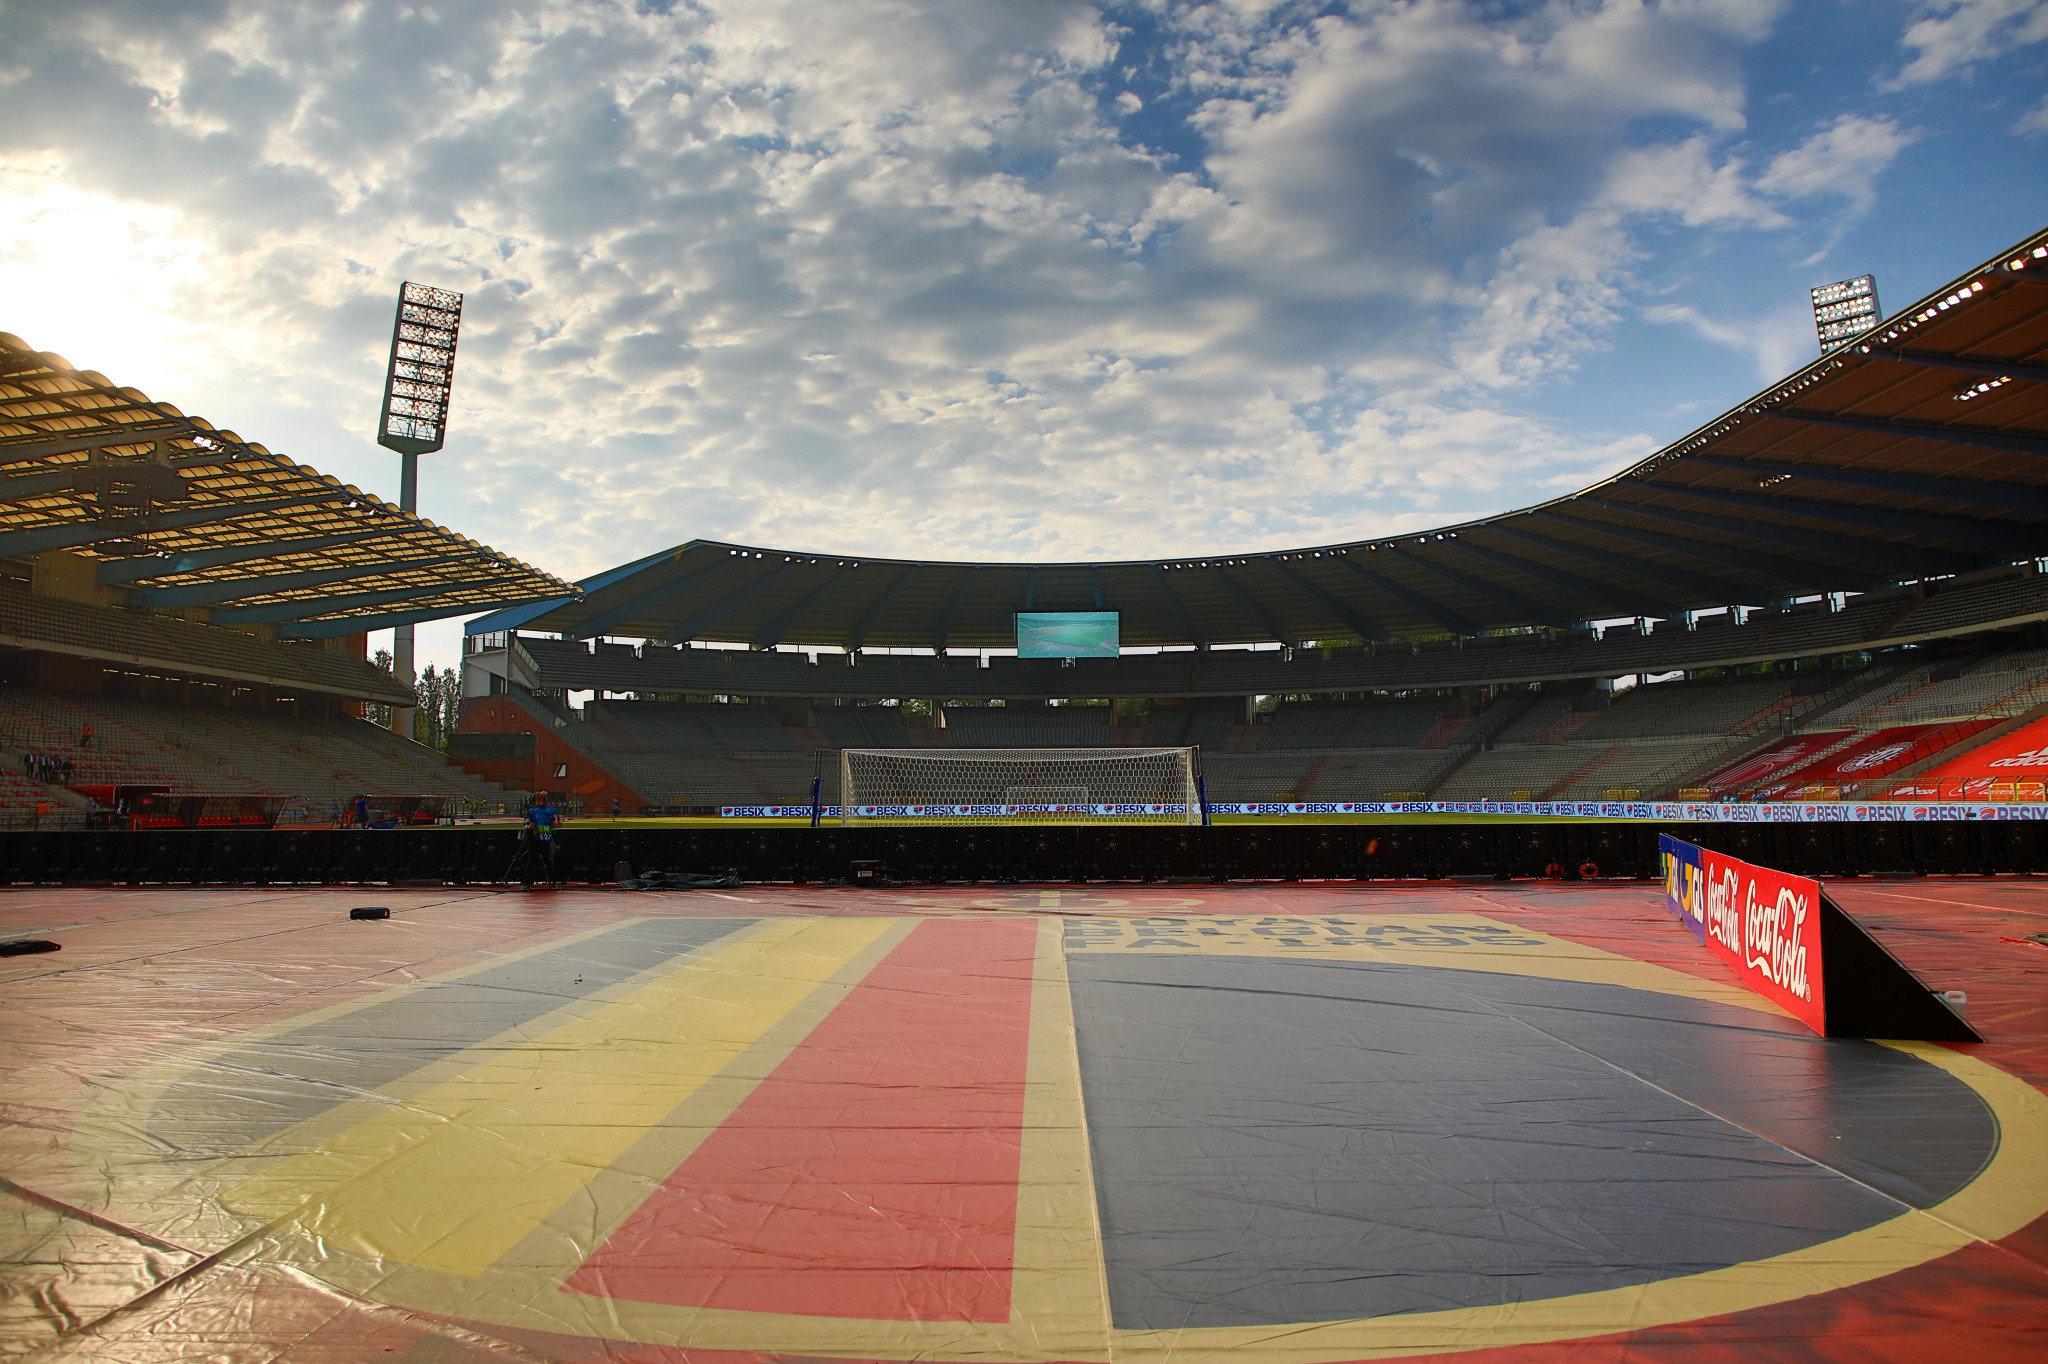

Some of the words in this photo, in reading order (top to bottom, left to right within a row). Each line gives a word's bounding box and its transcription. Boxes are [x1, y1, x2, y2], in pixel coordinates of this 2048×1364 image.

[734, 807, 765, 816] BESIX
[781, 807, 812, 816] BESIX
[876, 806, 908, 816] BESIX
[924, 806, 955, 815] BESIX
[971, 806, 1002, 815] BESIX
[1115, 805, 1146, 814] BESIX
[1210, 804, 1241, 813] BESIX
[1258, 804, 1289, 813] BESIX
[1306, 804, 1337, 813] BESIX
[1354, 804, 1385, 812] BESIX
[1402, 803, 1433, 812] BESIX
[1504, 803, 1517, 813] BESIX
[1520, 803, 1533, 814] BESIX
[1561, 803, 1575, 815] BESIX
[1583, 804, 1599, 816] BESIX
[1608, 804, 1625, 816] BESIX
[1633, 804, 1653, 817] BESIX
[1663, 805, 1684, 819] BESIX
[1731, 805, 1758, 821] BESIX
[1772, 806, 1802, 821] BESIX
[1817, 806, 1849, 822] BESIX
[1868, 806, 1906, 821] BESIX
[1708, 862, 1739, 954] Coca-Cola
[1064, 925, 1511, 937] BELGIAN
[1745, 879, 1808, 999] Coca-Cola
[1064, 938, 1201, 948] FA
[1263, 936, 1546, 947] 1895
